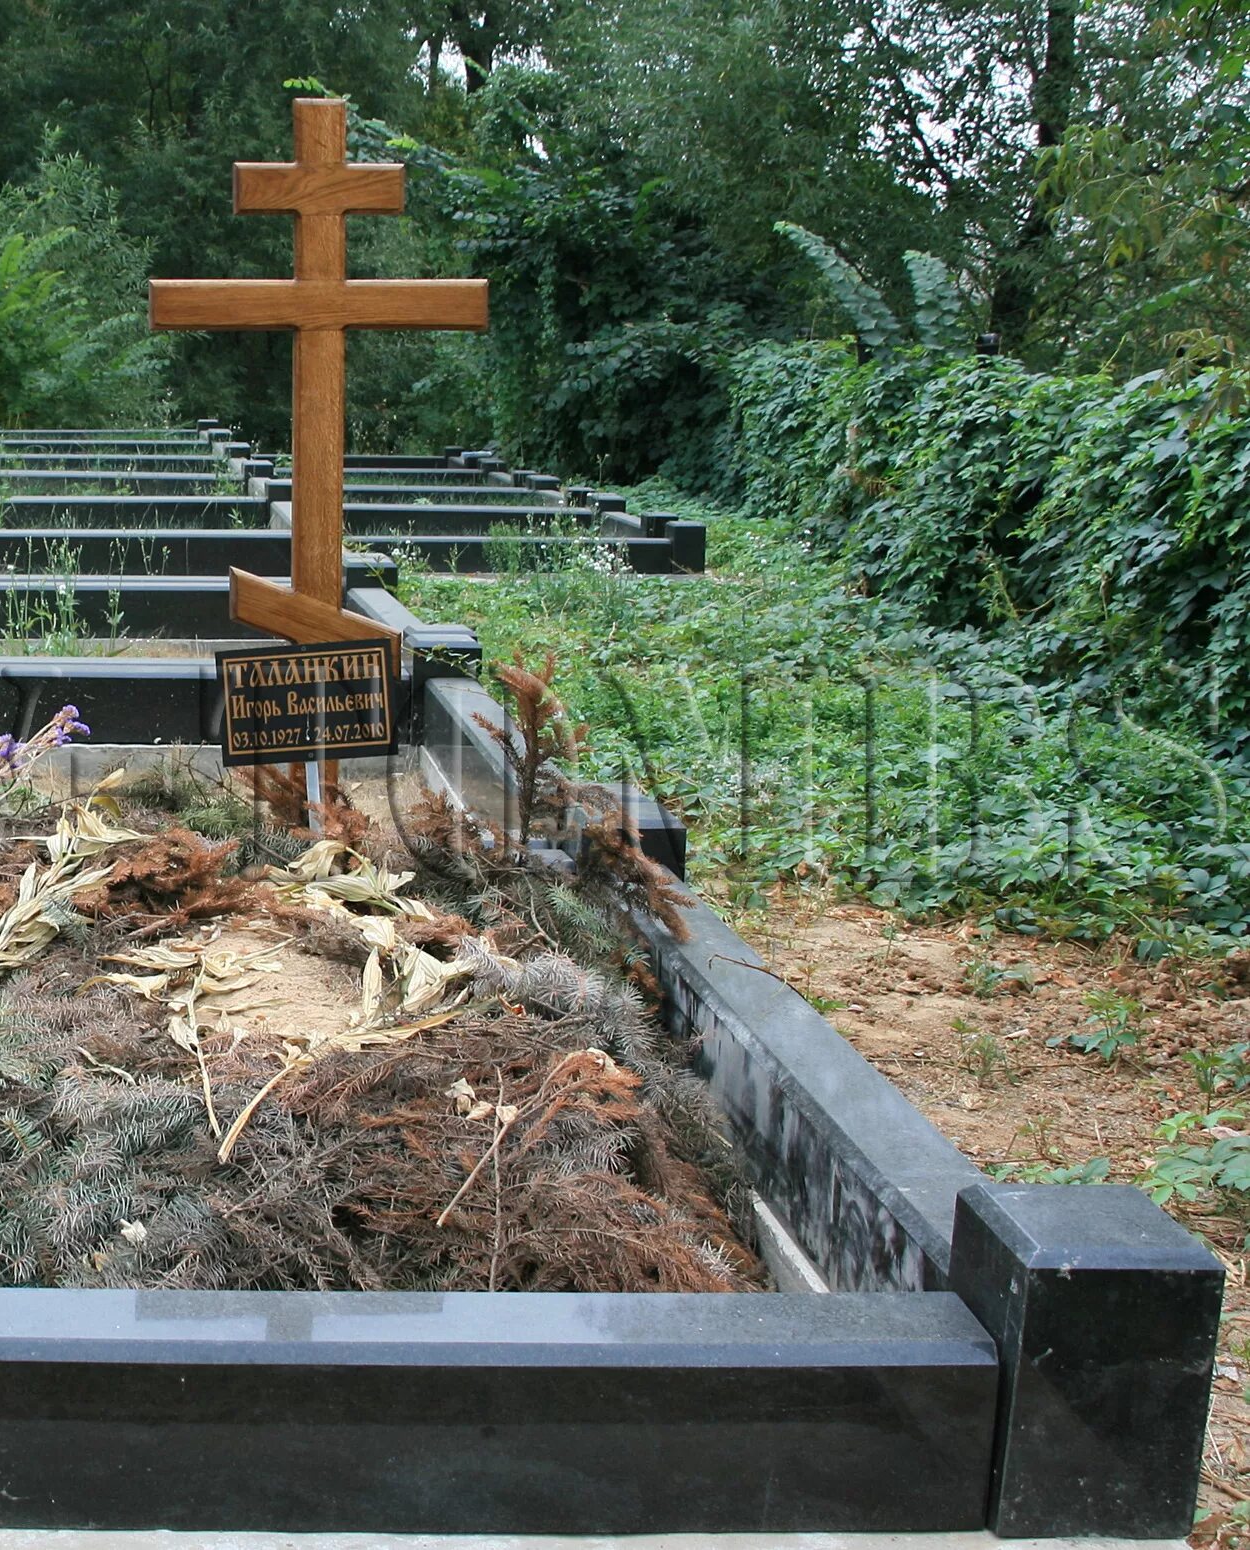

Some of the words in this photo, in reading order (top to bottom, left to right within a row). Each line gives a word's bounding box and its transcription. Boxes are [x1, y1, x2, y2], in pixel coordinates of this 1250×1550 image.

[229, 653, 382, 689] ТАЛАНКИН
[230, 694, 282, 723] Игорь
[286, 690, 384, 716] Васильевич
[232, 727, 301, 748] 03.10.1927
[314, 721, 385, 742] 24.07.2010
